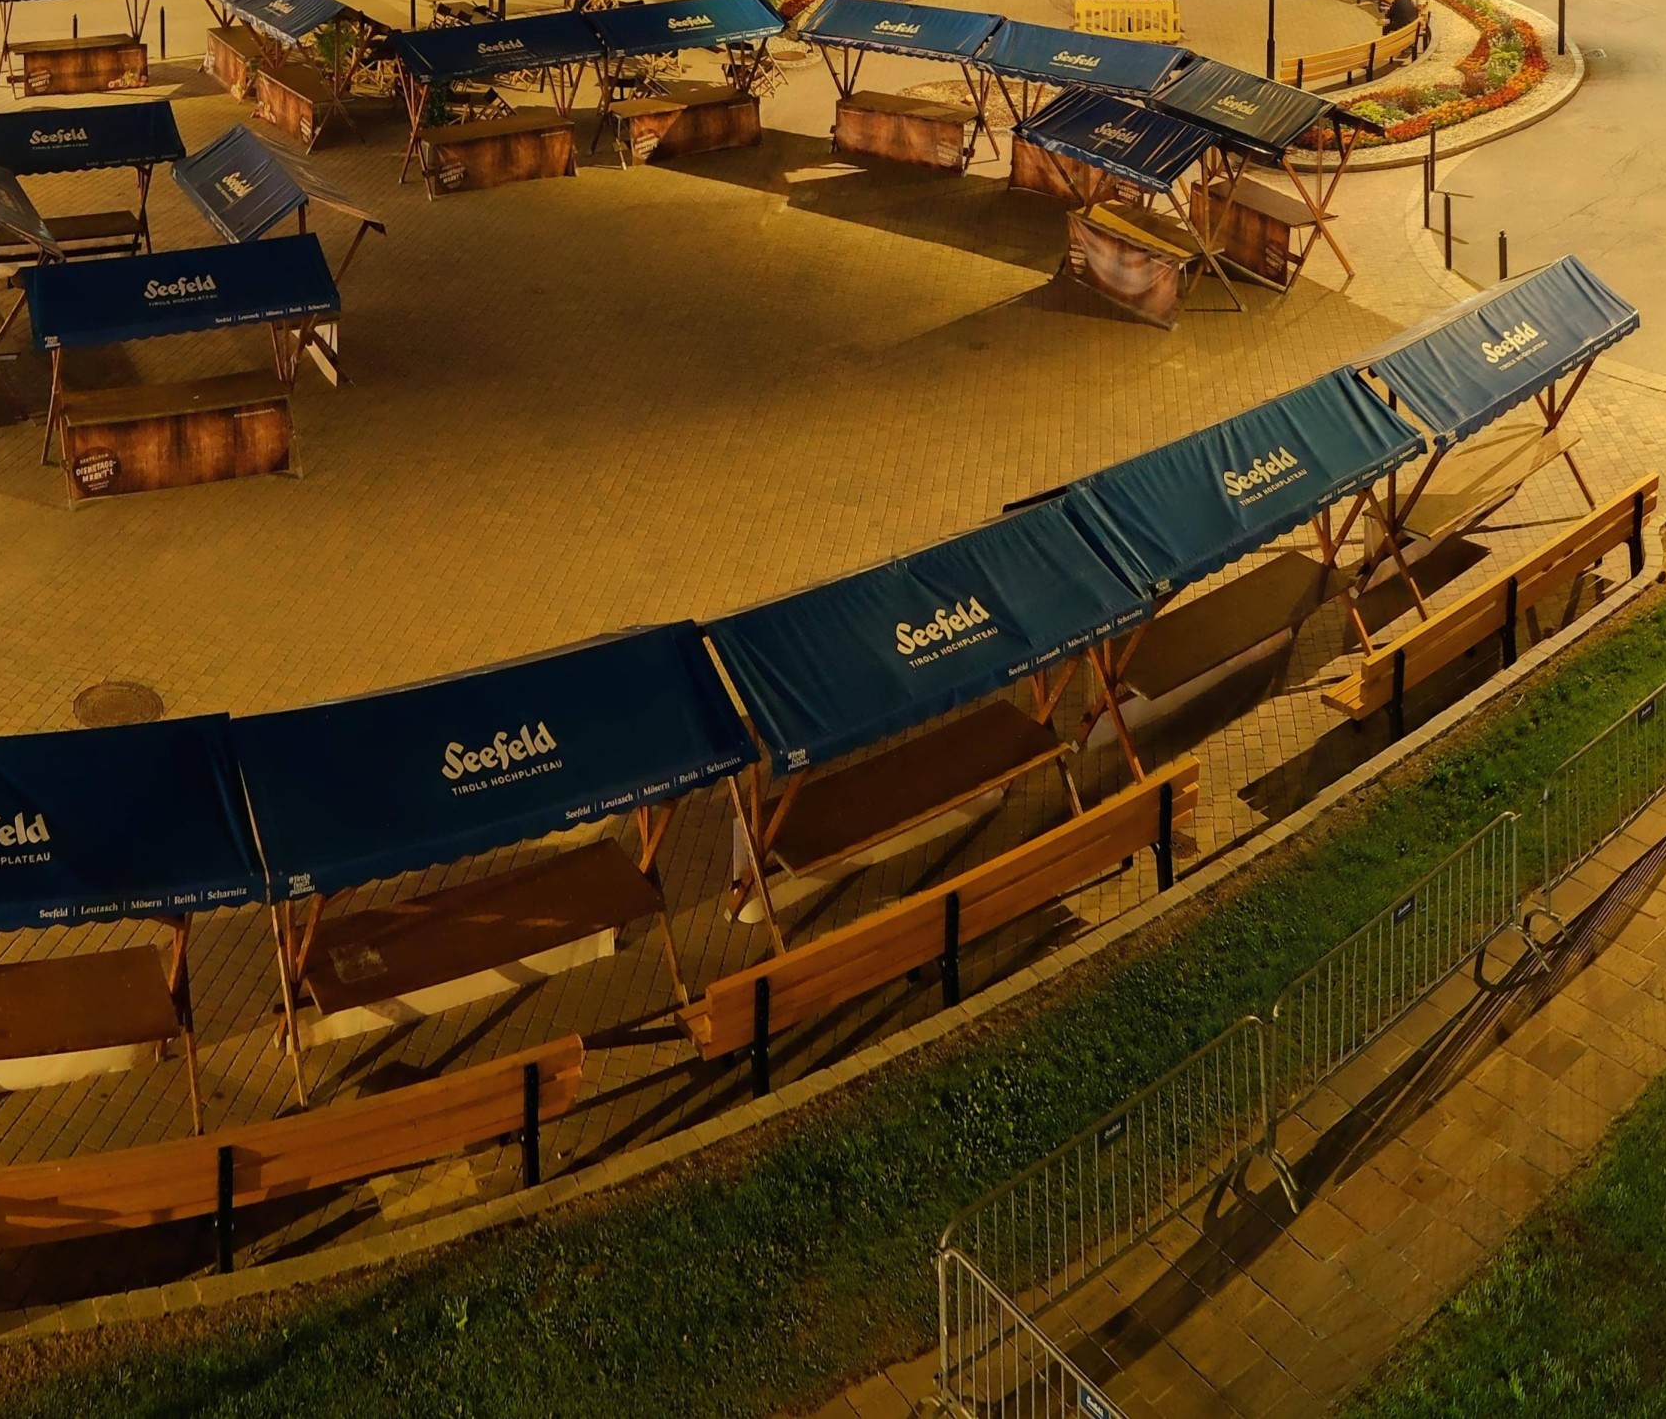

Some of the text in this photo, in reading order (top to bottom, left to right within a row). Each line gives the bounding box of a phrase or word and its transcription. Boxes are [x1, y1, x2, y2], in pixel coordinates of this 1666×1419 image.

[667, 14, 712, 30] Seefeld
[875, 19, 921, 35] Seefeld
[477, 39, 524, 54] Seefeld
[1052, 50, 1101, 68] Seefeld
[1217, 95, 1260, 116] Seefeld
[29, 128, 88, 144] Seefeld
[1094, 122, 1139, 143] Seefeld
[144, 274, 217, 299] Seefeld
[1481, 320, 1539, 364] Seefeld
[1223, 446, 1298, 496] Seefeld
[1239, 468, 1308, 507] TIROLS HOCHPLATEAU
[895, 595, 991, 656] Seefeld
[909, 626, 999, 669] TIROLS HOCHPLATEAU
[441, 721, 558, 780] Seefeld
[451, 759, 563, 797] TIROLS HOCHPLATEAU
[565, 755, 742, 820] Seefeld Leutasch Mösern Reith Scharnitz
[39, 886, 248, 919] Seefeld Leutasch Mösern Reith Scharnitz
